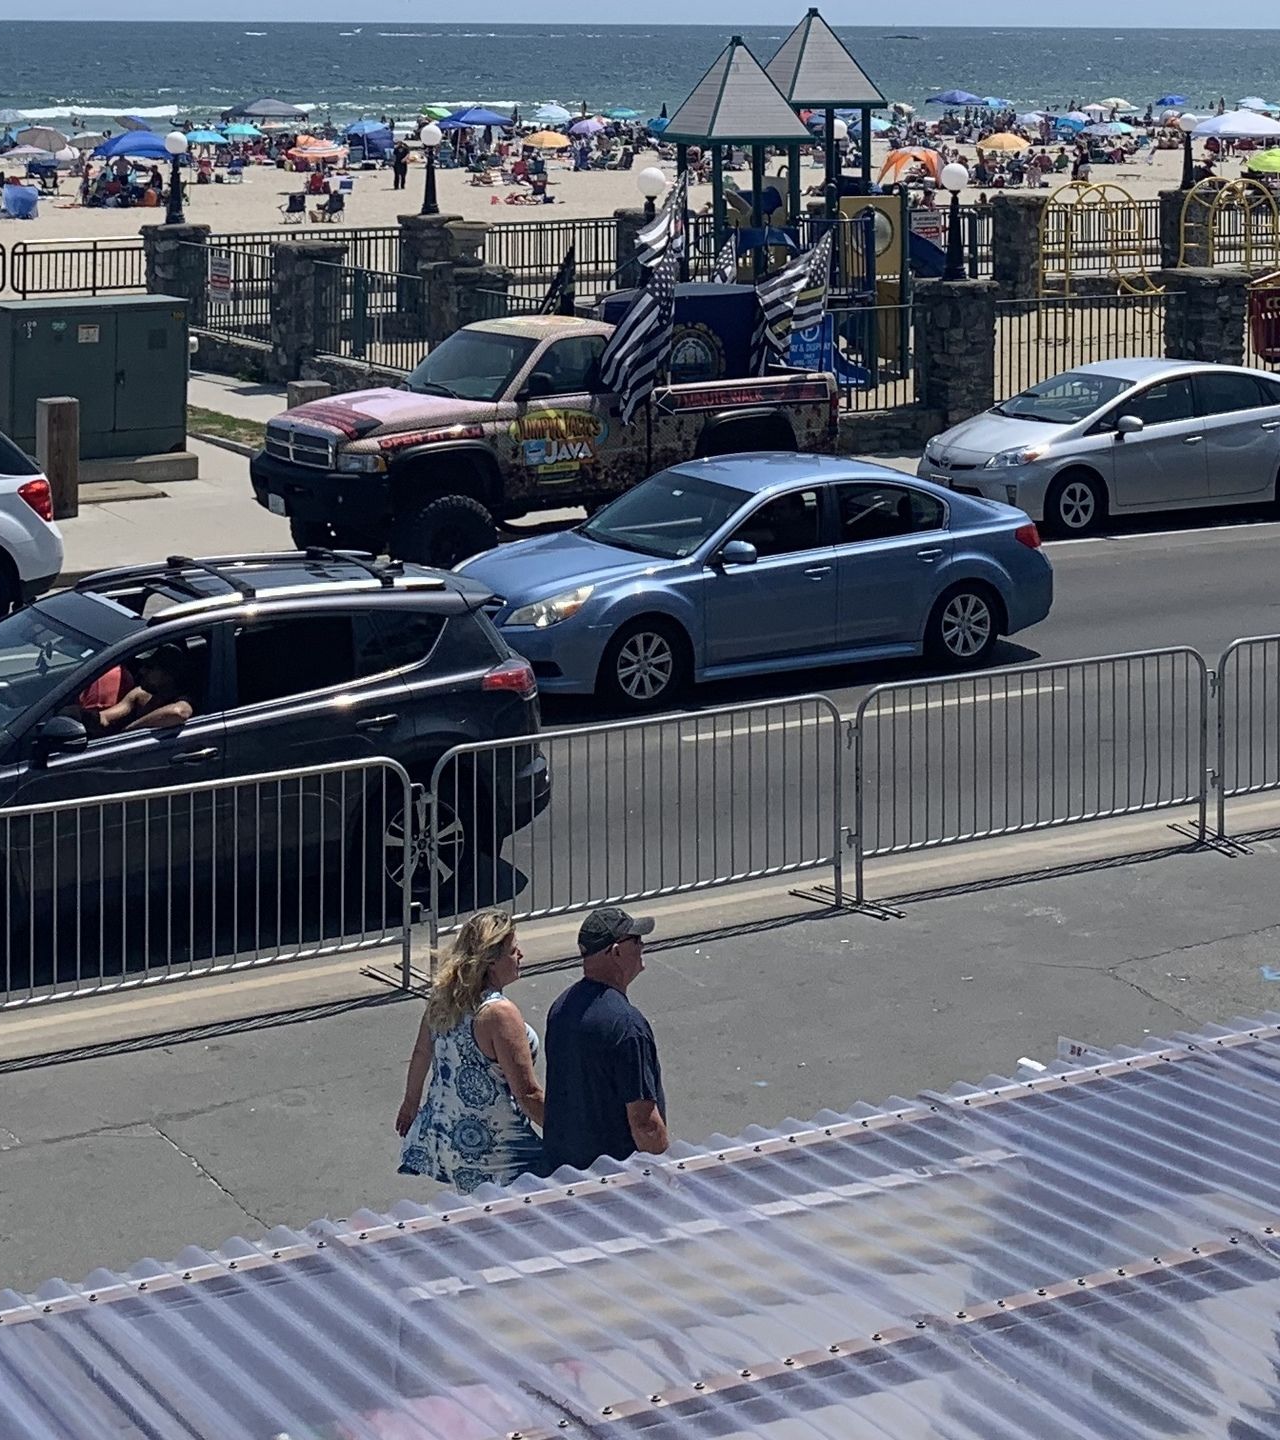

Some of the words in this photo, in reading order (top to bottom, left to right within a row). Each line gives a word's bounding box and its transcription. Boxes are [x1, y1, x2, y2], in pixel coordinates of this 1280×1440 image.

[806, 343, 831, 352] DISPAY
[380, 433, 424, 448] OPEN
[544, 440, 594, 464] JAVA
